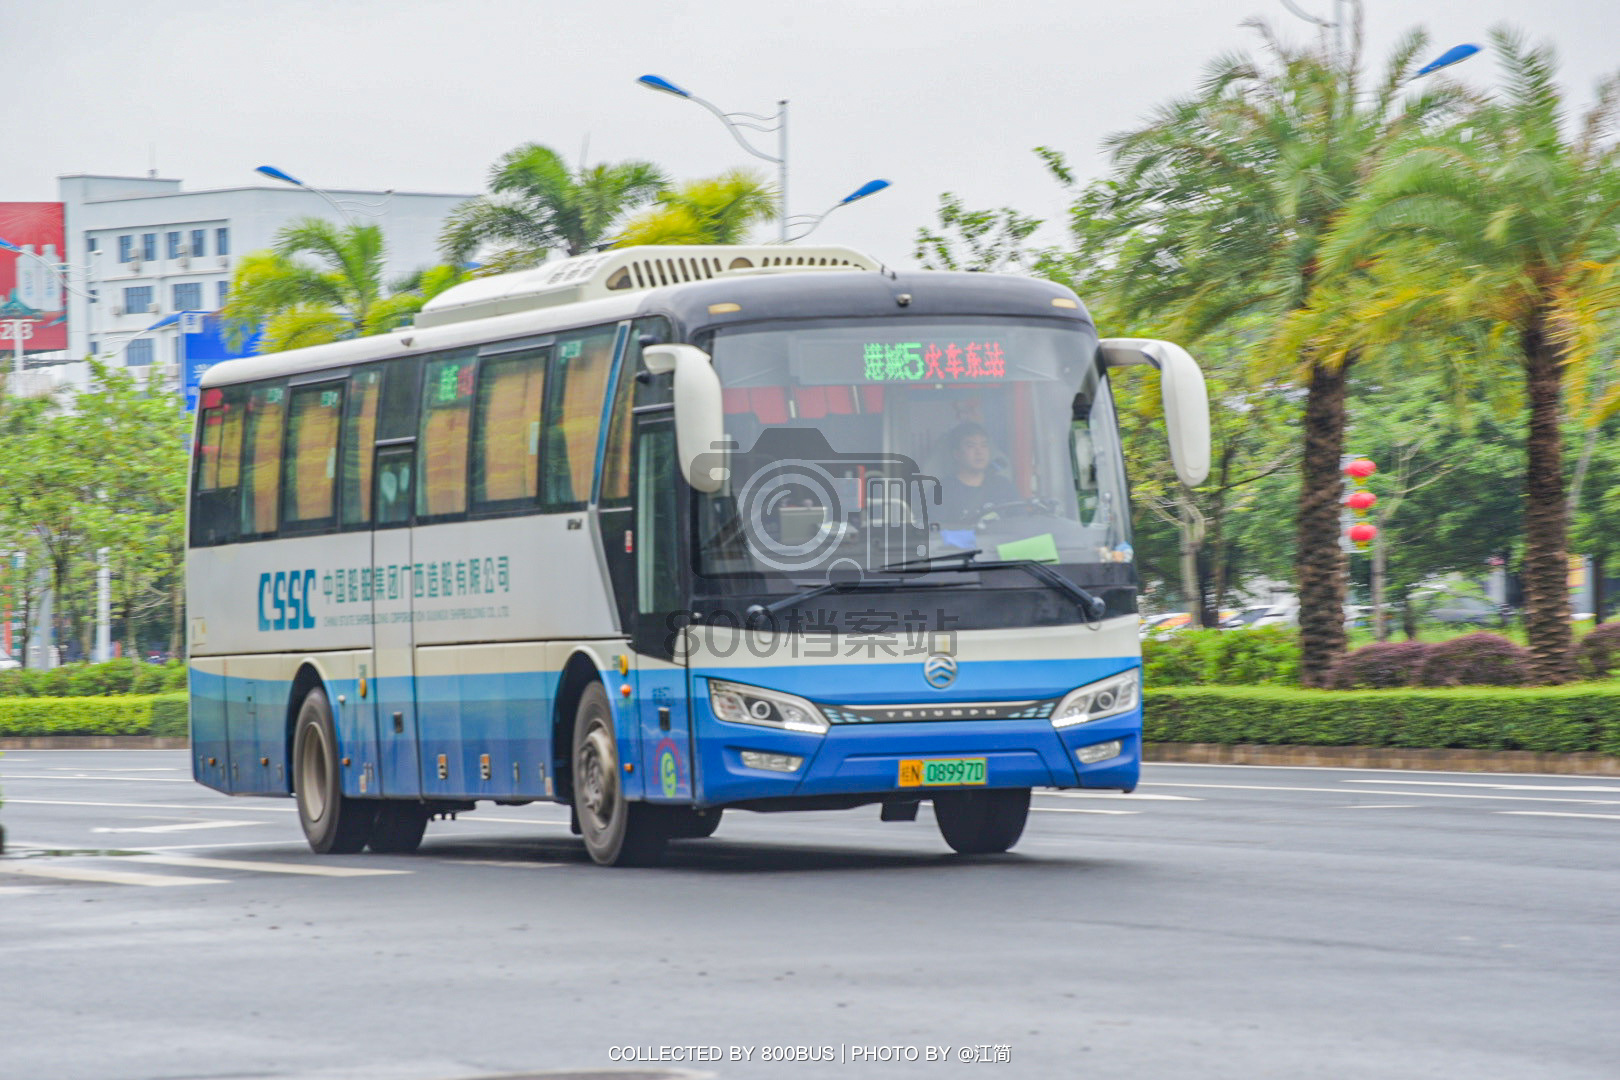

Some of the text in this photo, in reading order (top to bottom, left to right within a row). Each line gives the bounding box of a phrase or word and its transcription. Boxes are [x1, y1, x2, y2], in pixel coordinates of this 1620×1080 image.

[258, 569, 316, 632] CSSC
[323, 556, 510, 605] 中国船舶集团广西造船有限公司
